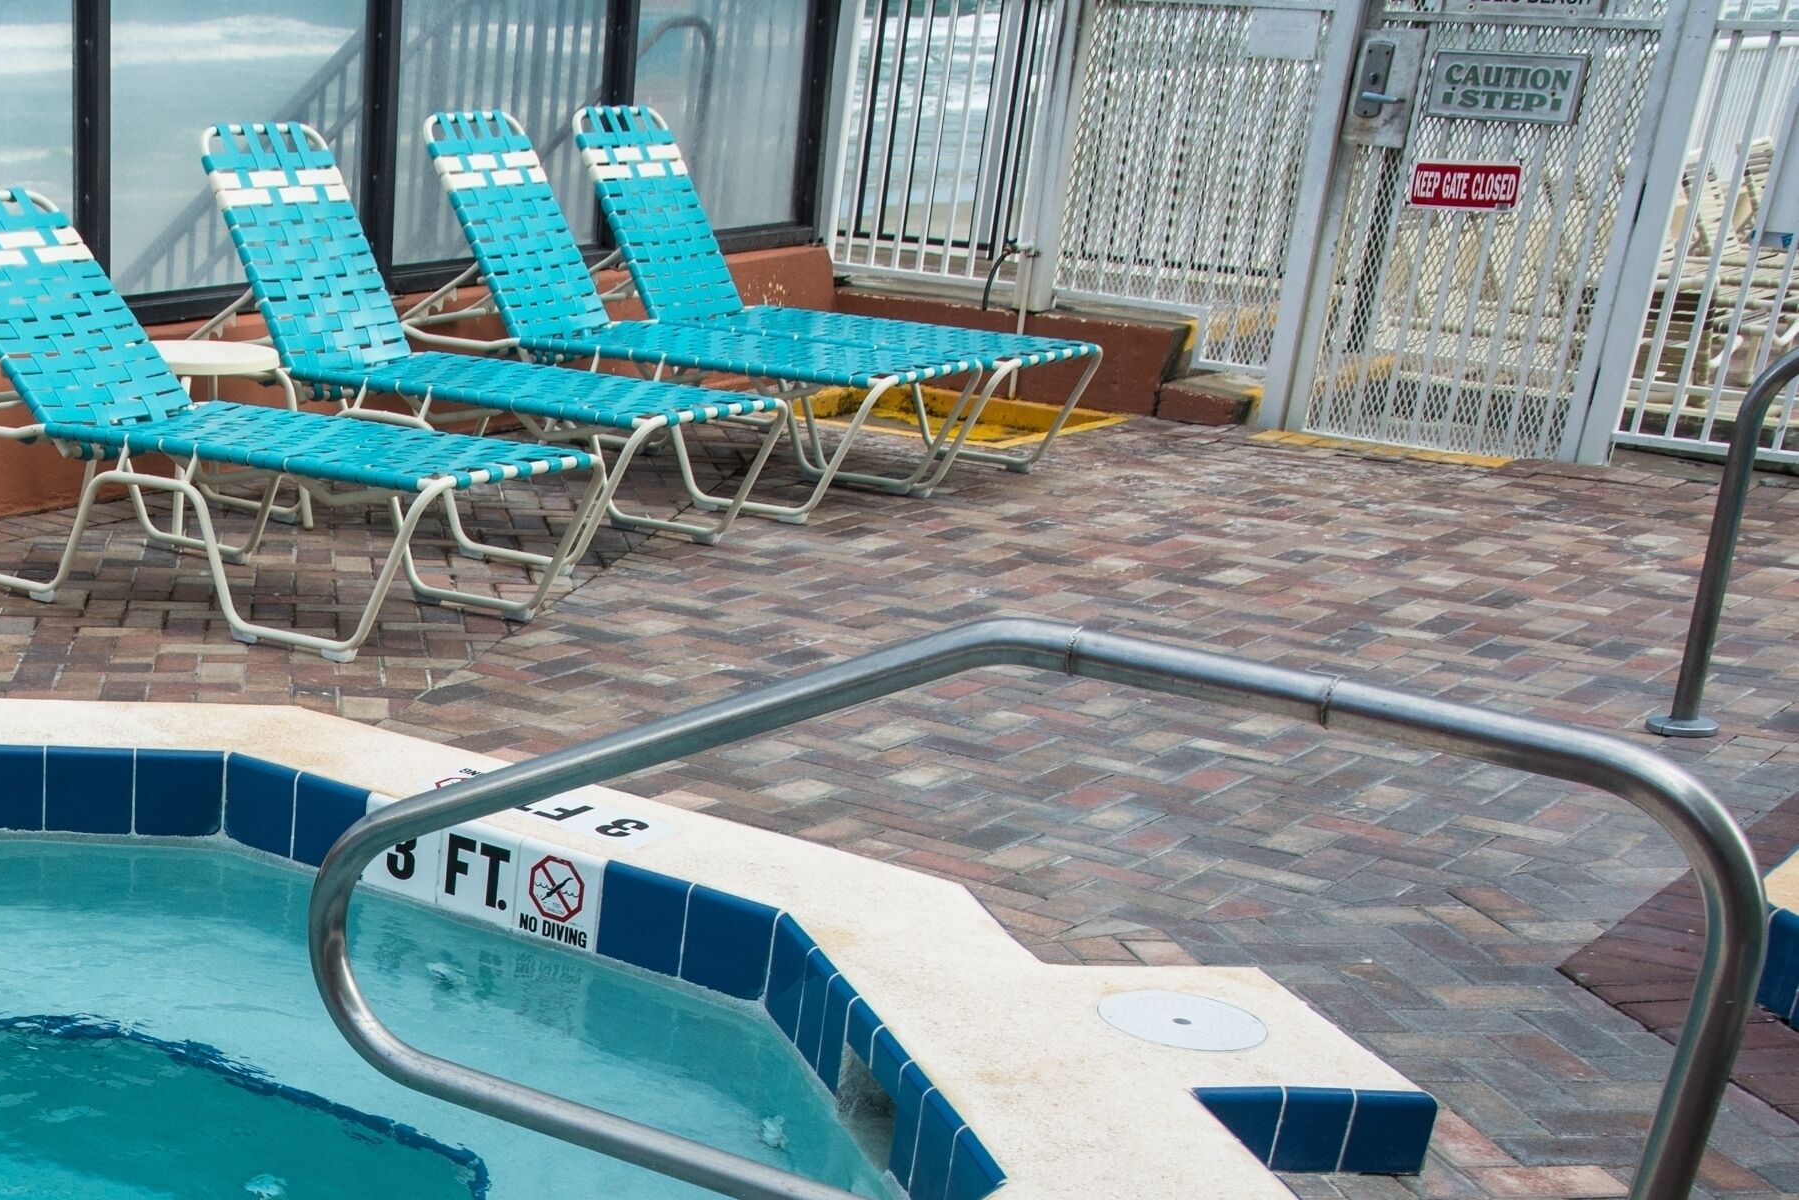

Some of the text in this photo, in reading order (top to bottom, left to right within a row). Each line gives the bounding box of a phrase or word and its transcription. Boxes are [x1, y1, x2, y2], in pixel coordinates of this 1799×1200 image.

[1445, 64, 1573, 91] CAUTION
[1457, 89, 1548, 111] STEP
[1414, 171, 1517, 200] KEEP GATE CLOSED
[595, 819, 649, 837] 3
[444, 833, 511, 911] FT.
[519, 912, 587, 948] NO DIVING
